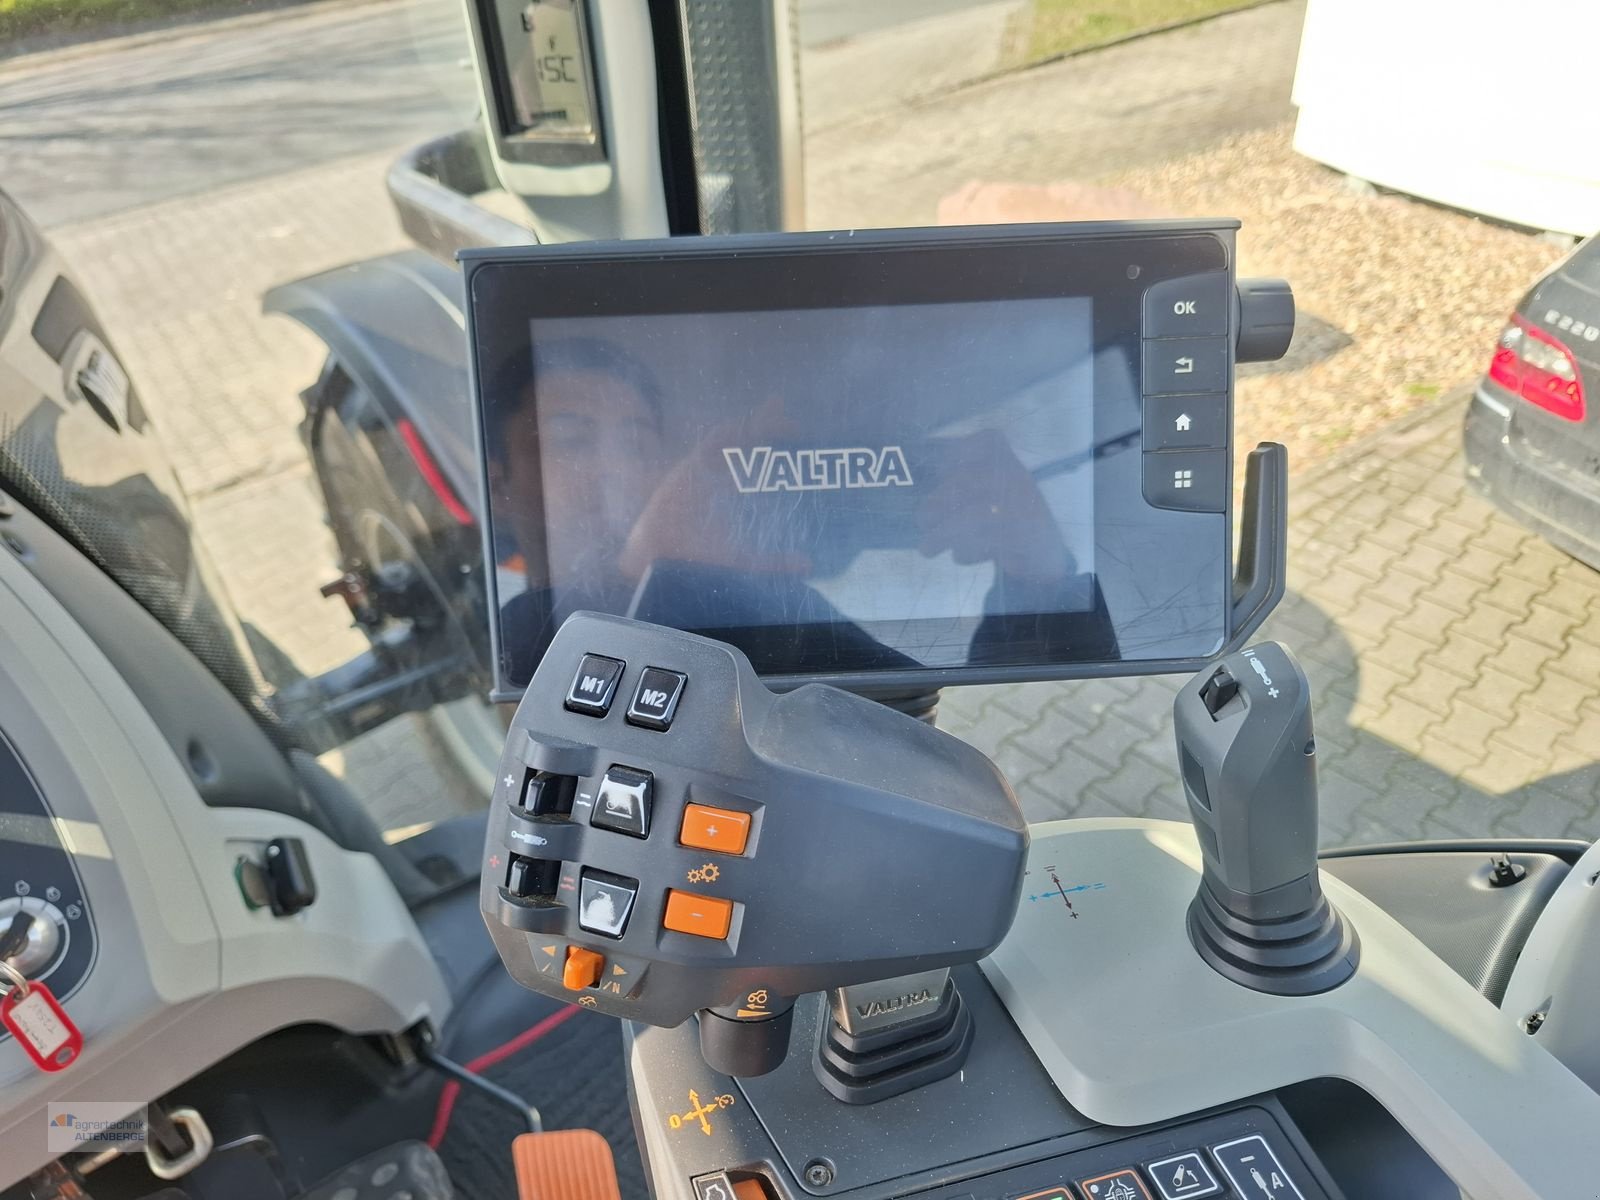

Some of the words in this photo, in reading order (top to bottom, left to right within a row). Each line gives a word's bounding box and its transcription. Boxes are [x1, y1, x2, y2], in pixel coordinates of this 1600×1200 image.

[1174, 301, 1196, 315] OK
[722, 446, 914, 493] VALTRA
[580, 675, 605, 695] M1
[640, 689, 667, 708] M2
[855, 988, 939, 1020] VALTRA
[1271, 1172, 1284, 1190] A
